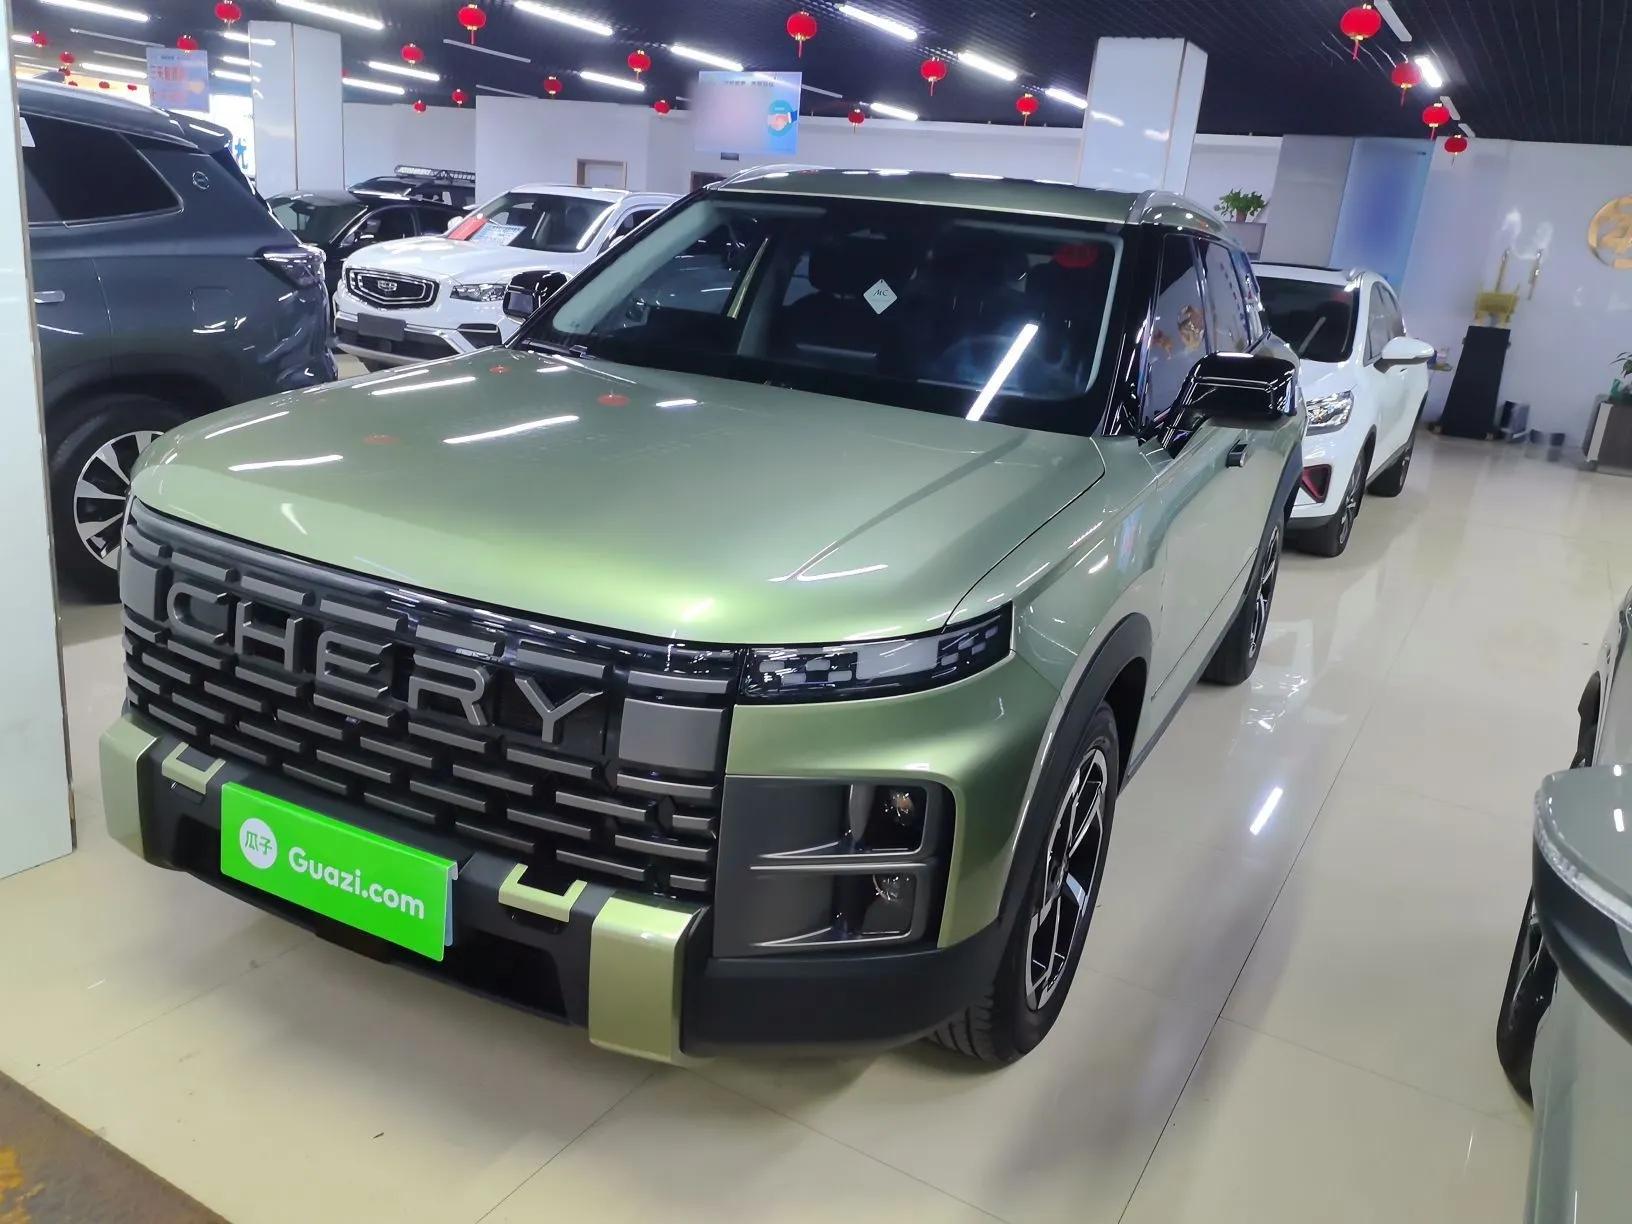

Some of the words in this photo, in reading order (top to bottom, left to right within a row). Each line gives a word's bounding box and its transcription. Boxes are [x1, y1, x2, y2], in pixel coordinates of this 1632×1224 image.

[167, 580, 603, 742] CHERY
[244, 830, 273, 856] 瓜子
[288, 846, 425, 920] Guazi.com
